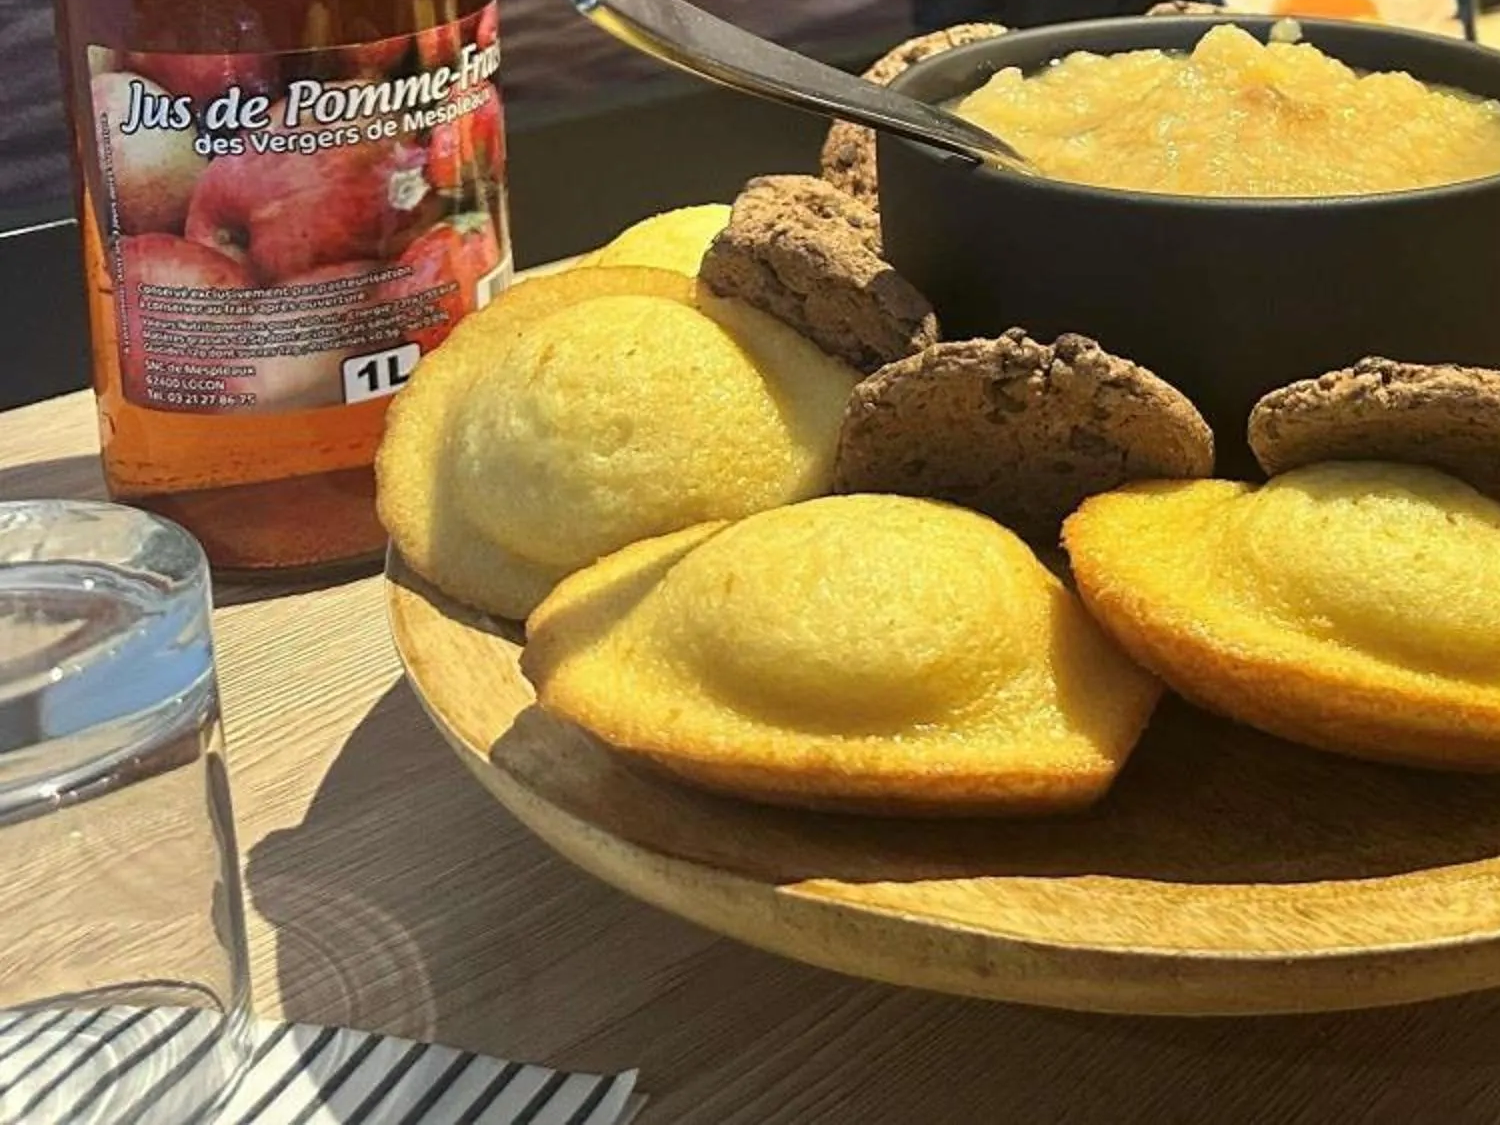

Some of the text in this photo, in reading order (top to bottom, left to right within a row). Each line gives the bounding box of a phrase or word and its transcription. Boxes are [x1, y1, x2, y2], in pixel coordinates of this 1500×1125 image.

[121, 81, 192, 133] Jus
[206, 87, 270, 130] de
[194, 134, 245, 155] des
[250, 126, 361, 155] Vergers
[367, 118, 399, 141] de
[358, 355, 410, 391] 1L
